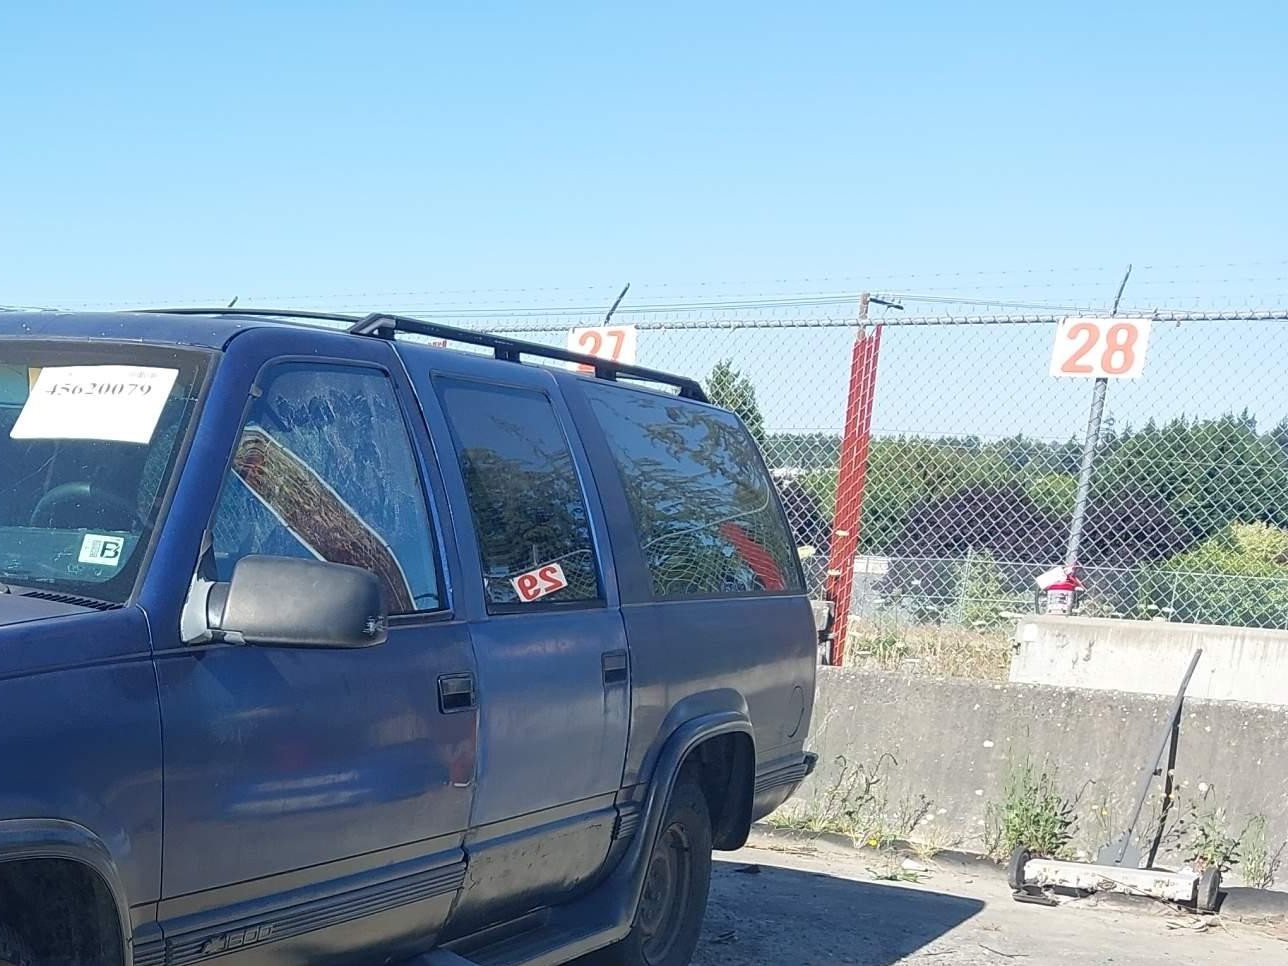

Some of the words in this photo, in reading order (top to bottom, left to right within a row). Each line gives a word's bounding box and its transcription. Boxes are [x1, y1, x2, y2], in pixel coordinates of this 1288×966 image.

[576, 329, 627, 373] 27
[1060, 322, 1139, 375] 28
[45, 382, 152, 397] 45620079
